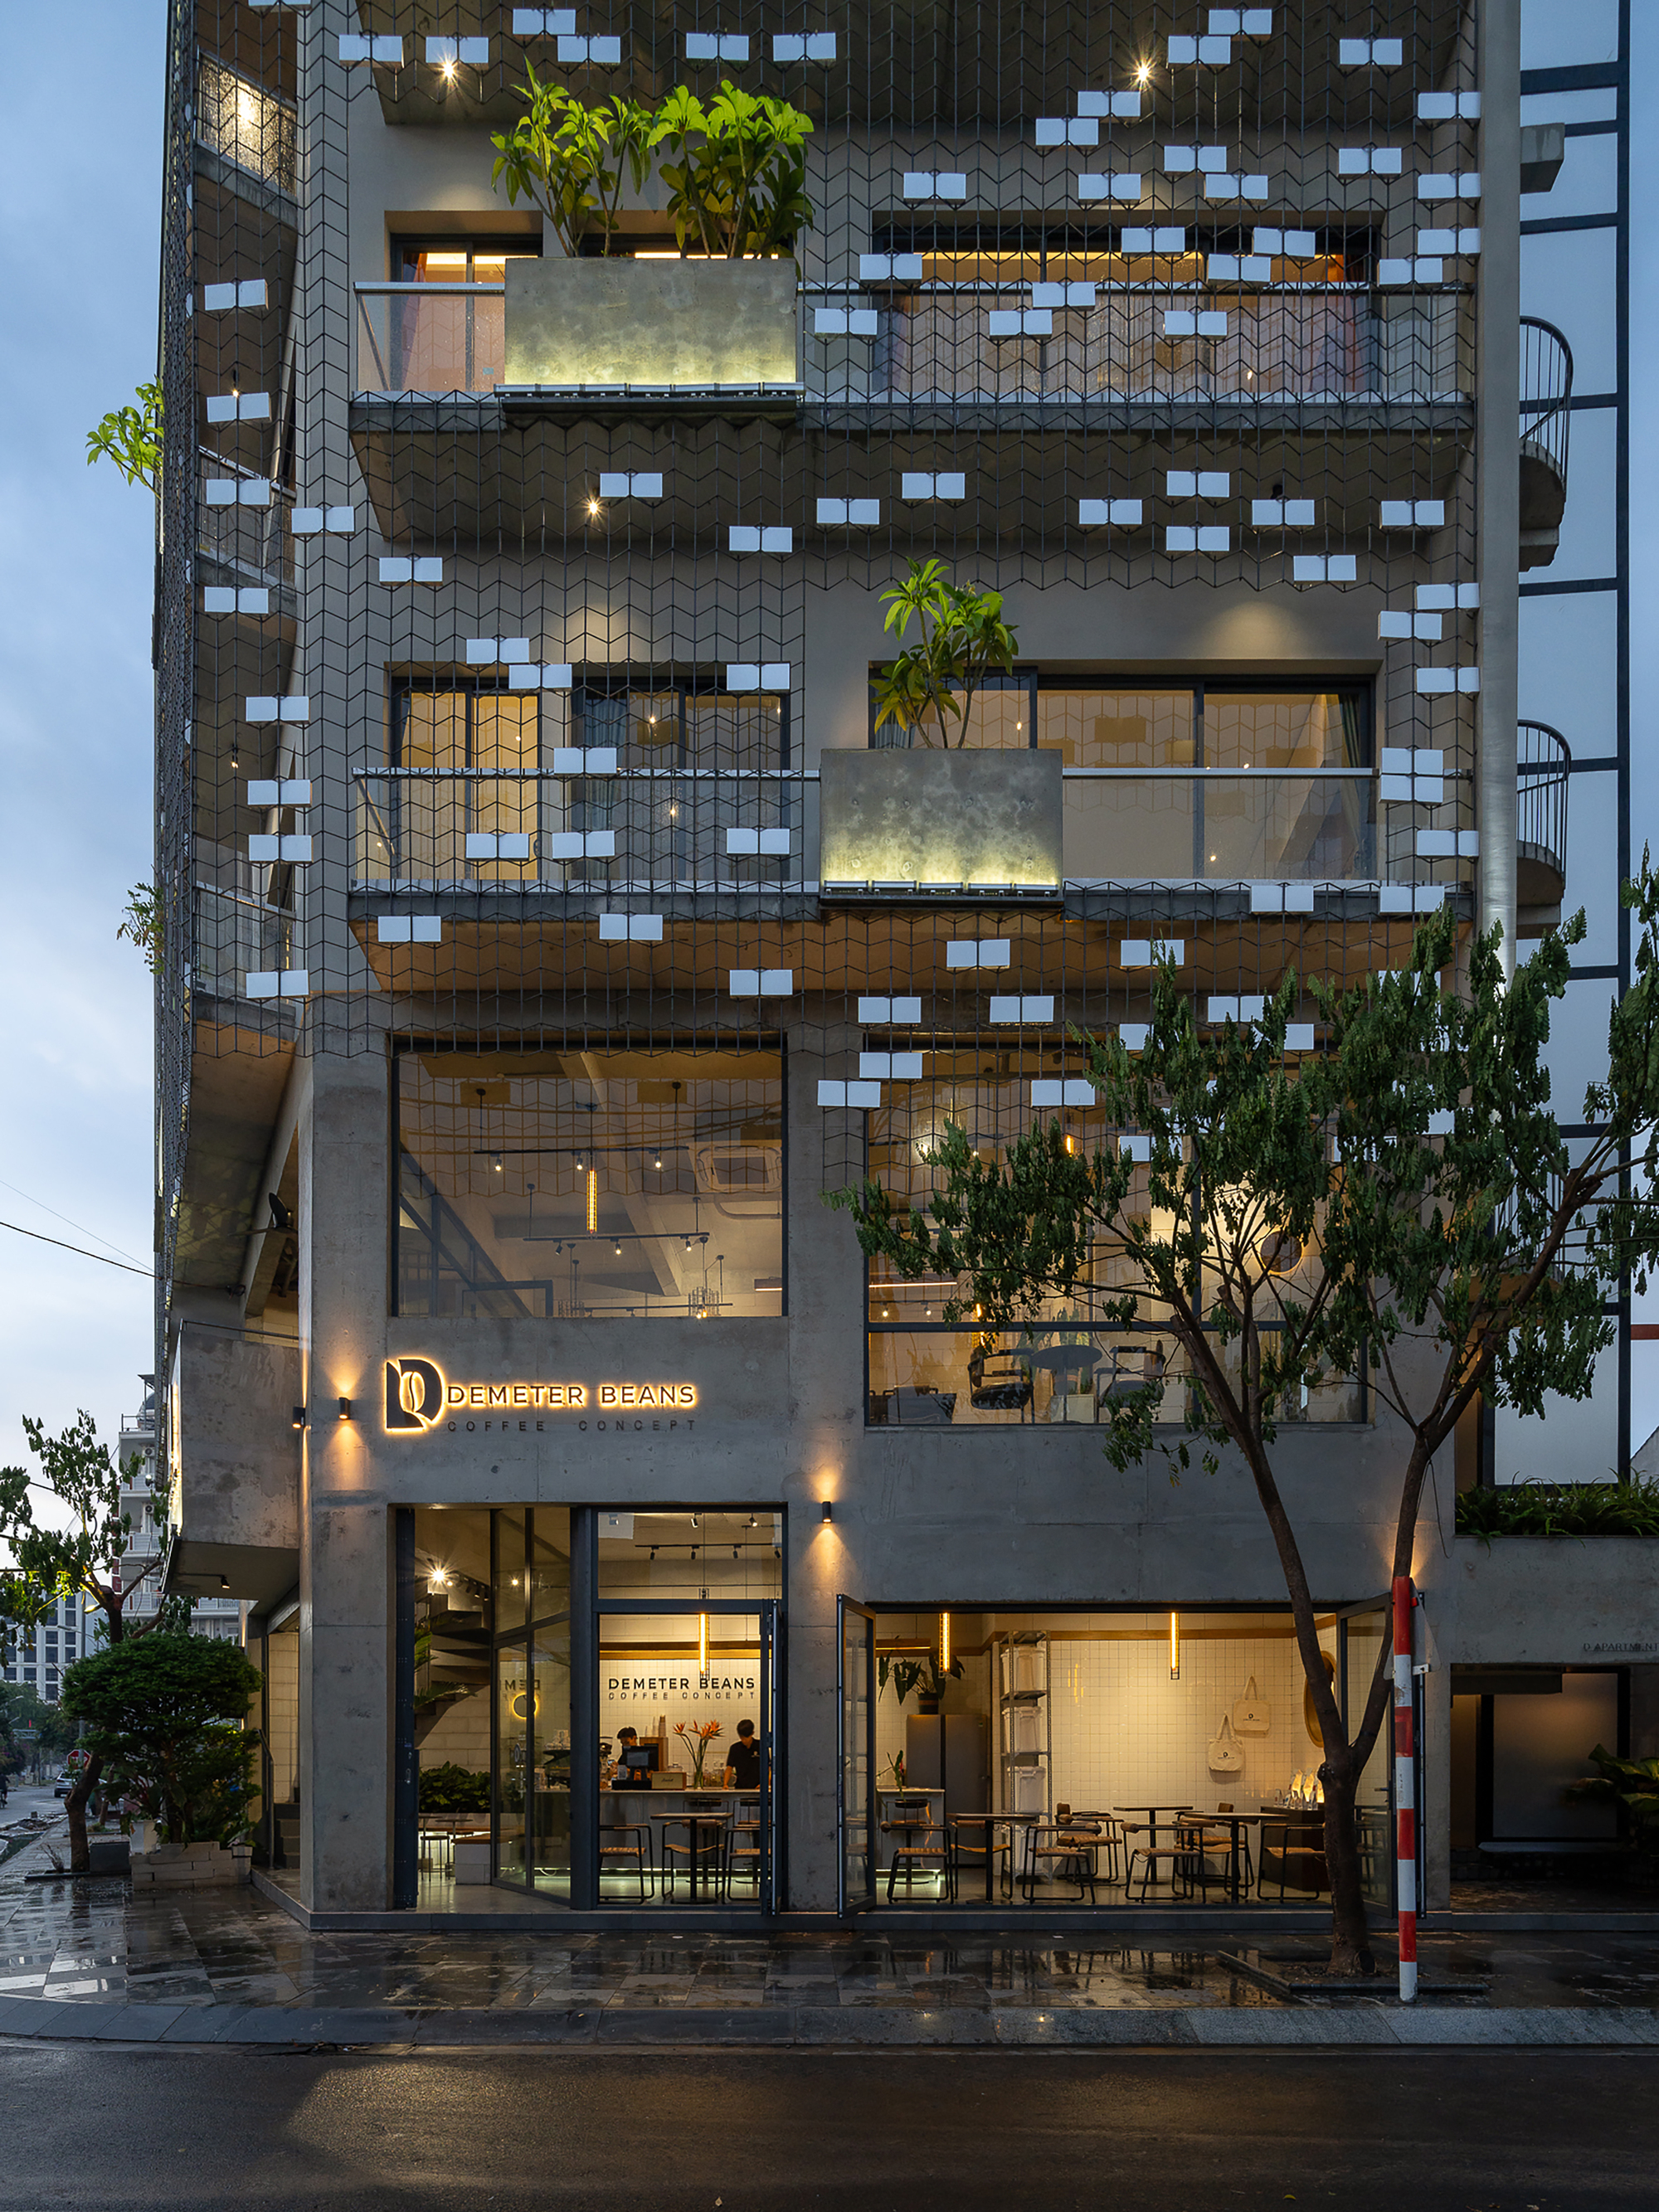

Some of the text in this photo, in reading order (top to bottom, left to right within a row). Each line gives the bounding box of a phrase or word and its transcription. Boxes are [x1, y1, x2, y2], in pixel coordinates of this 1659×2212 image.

[448, 1385, 693, 1404] DEMETER BEANS
[447, 1420, 695, 1432] COFFEE CONCEPT
[608, 1678, 755, 1689] DEMETER BEANS
[608, 1692, 754, 1700] COFFEE CONCEPT
